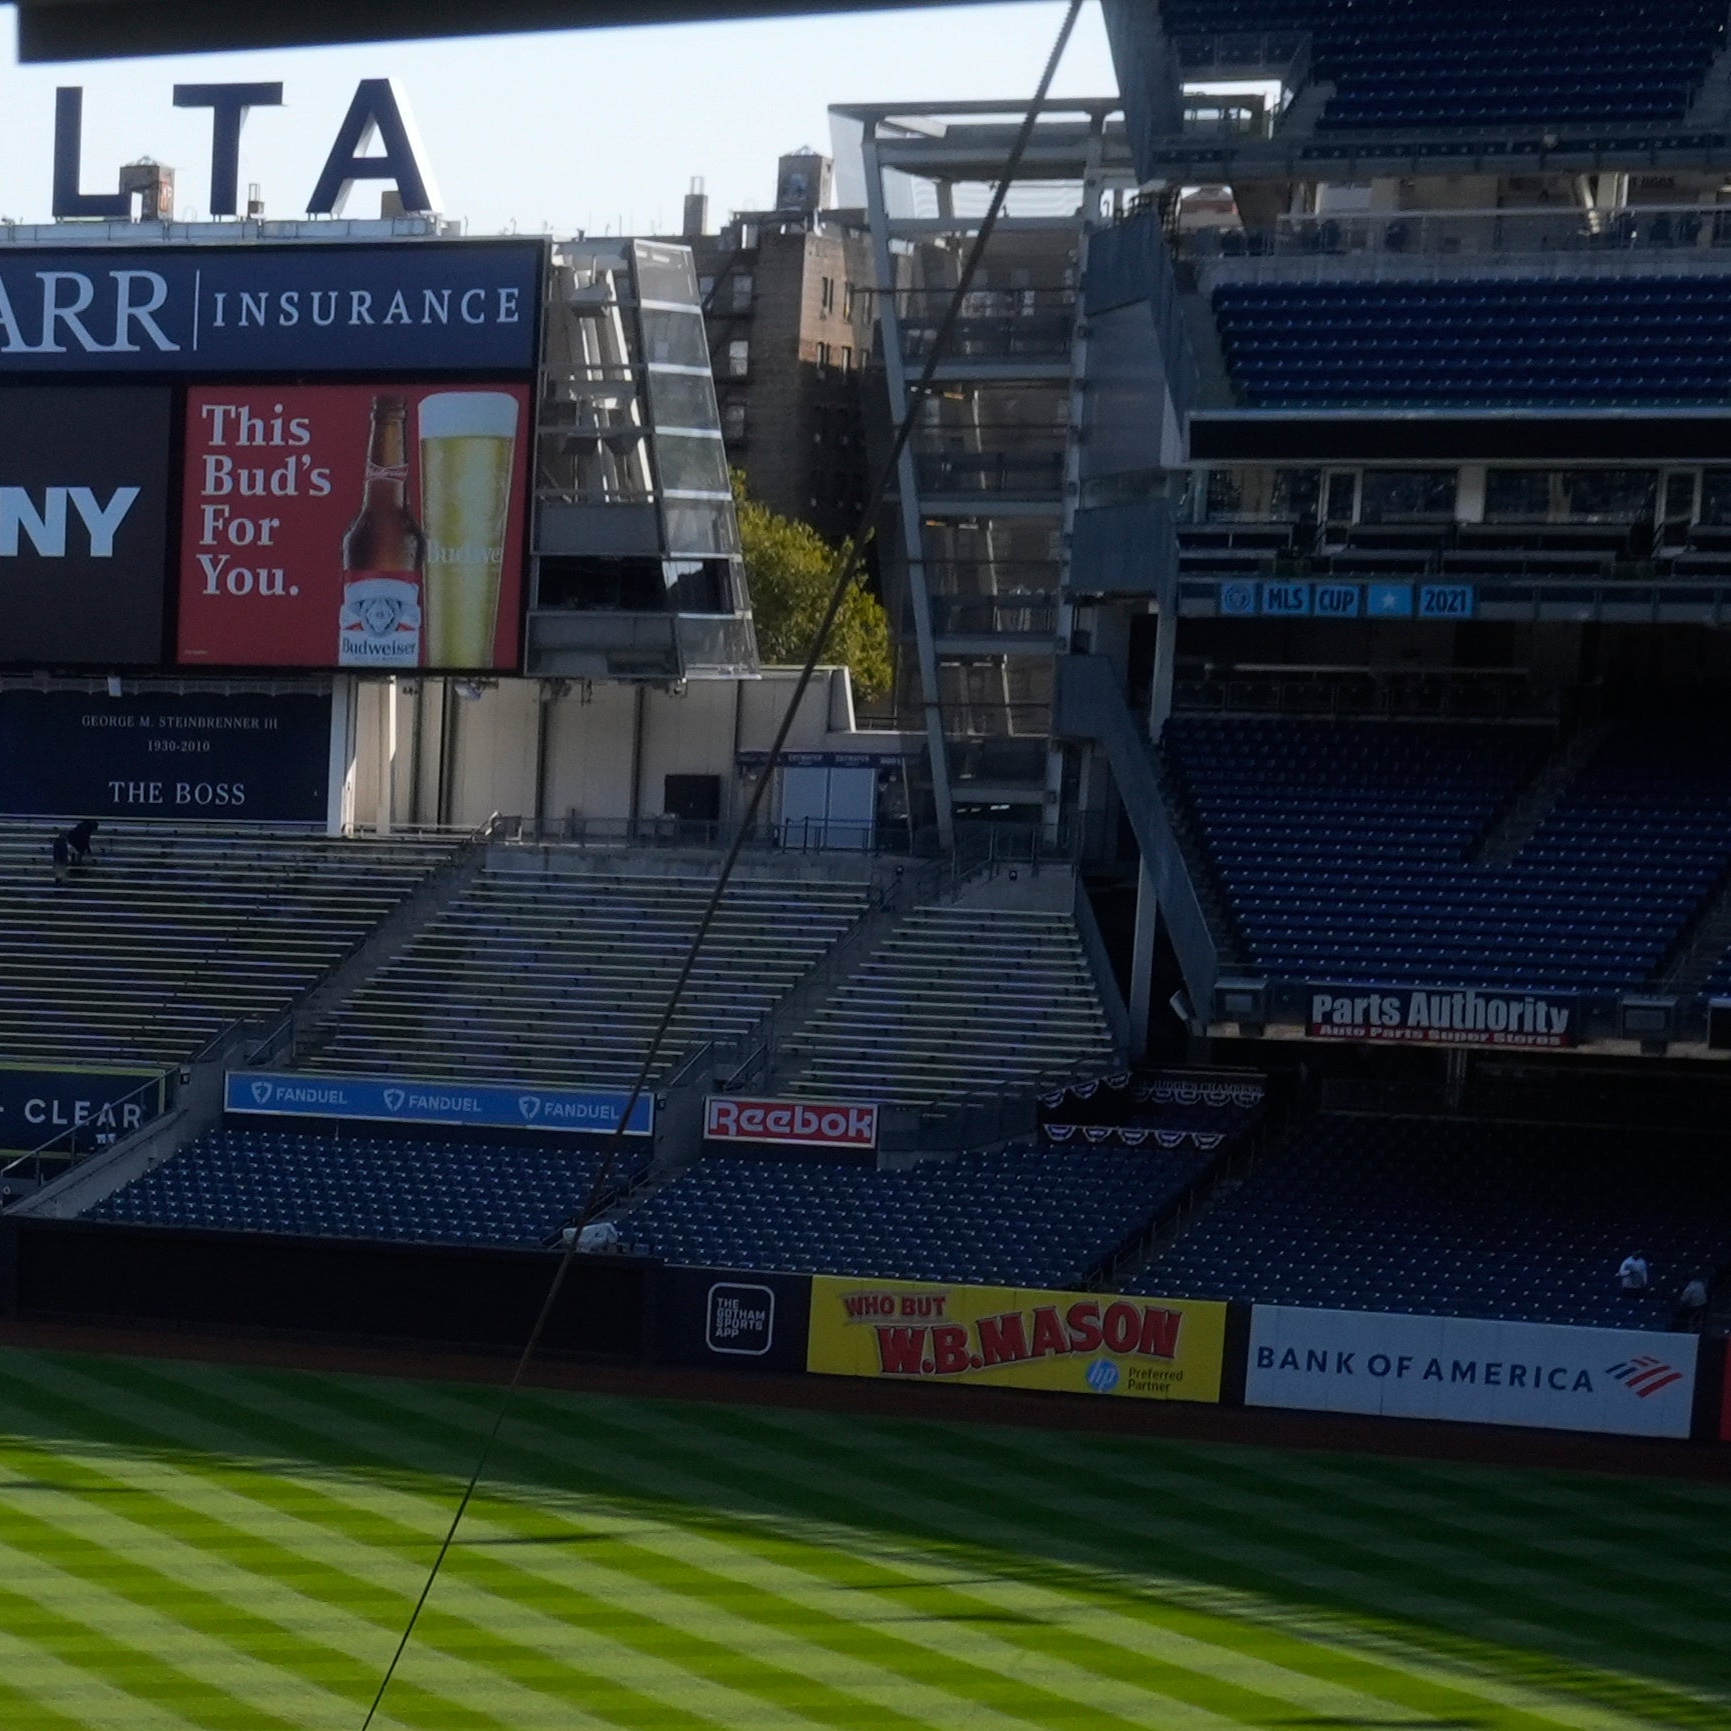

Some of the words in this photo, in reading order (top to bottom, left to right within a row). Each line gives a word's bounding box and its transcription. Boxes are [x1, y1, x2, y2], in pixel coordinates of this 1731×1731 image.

[213, 288, 520, 329] INSURANCE
[202, 403, 310, 447] This
[199, 504, 280, 546] For
[195, 553, 300, 597] You.
[1269, 588, 1302, 610] MLS
[1319, 588, 1354, 611] CUP
[1425, 589, 1466, 613] 2021
[342, 638, 417, 657] Budweiser
[82, 715, 134, 728] GEORGE
[140, 715, 155, 728] M.
[159, 716, 259, 730] STEINBRENNER
[264, 718, 278, 730] III
[147, 740, 210, 752] 1930-2010
[109, 781, 163, 804] THE
[176, 782, 245, 805] BOSS
[1312, 994, 1406, 1027] Parts
[1407, 990, 1570, 1035] Authority
[24, 1098, 142, 1129] CLEAR
[276, 1087, 347, 1105] FANDUEL
[408, 1095, 482, 1113] FANDUEL
[544, 1102, 620, 1120] FANDUEL
[709, 1101, 872, 1138] Reebok
[716, 1297, 740, 1309] THE
[716, 1308, 765, 1321] GOTHAM
[845, 1296, 896, 1318] WHO
[901, 1295, 946, 1316] BUT
[715, 1327, 740, 1338] APP
[716, 1319, 763, 1331] SPORTS
[1088, 1361, 1119, 1392] hp
[1128, 1367, 1183, 1382] Preferred
[1258, 1347, 1355, 1374] BANK
[1367, 1354, 1413, 1377] OF
[1423, 1358, 1594, 1393] AMERICA
[1128, 1379, 1170, 1393] Partner
